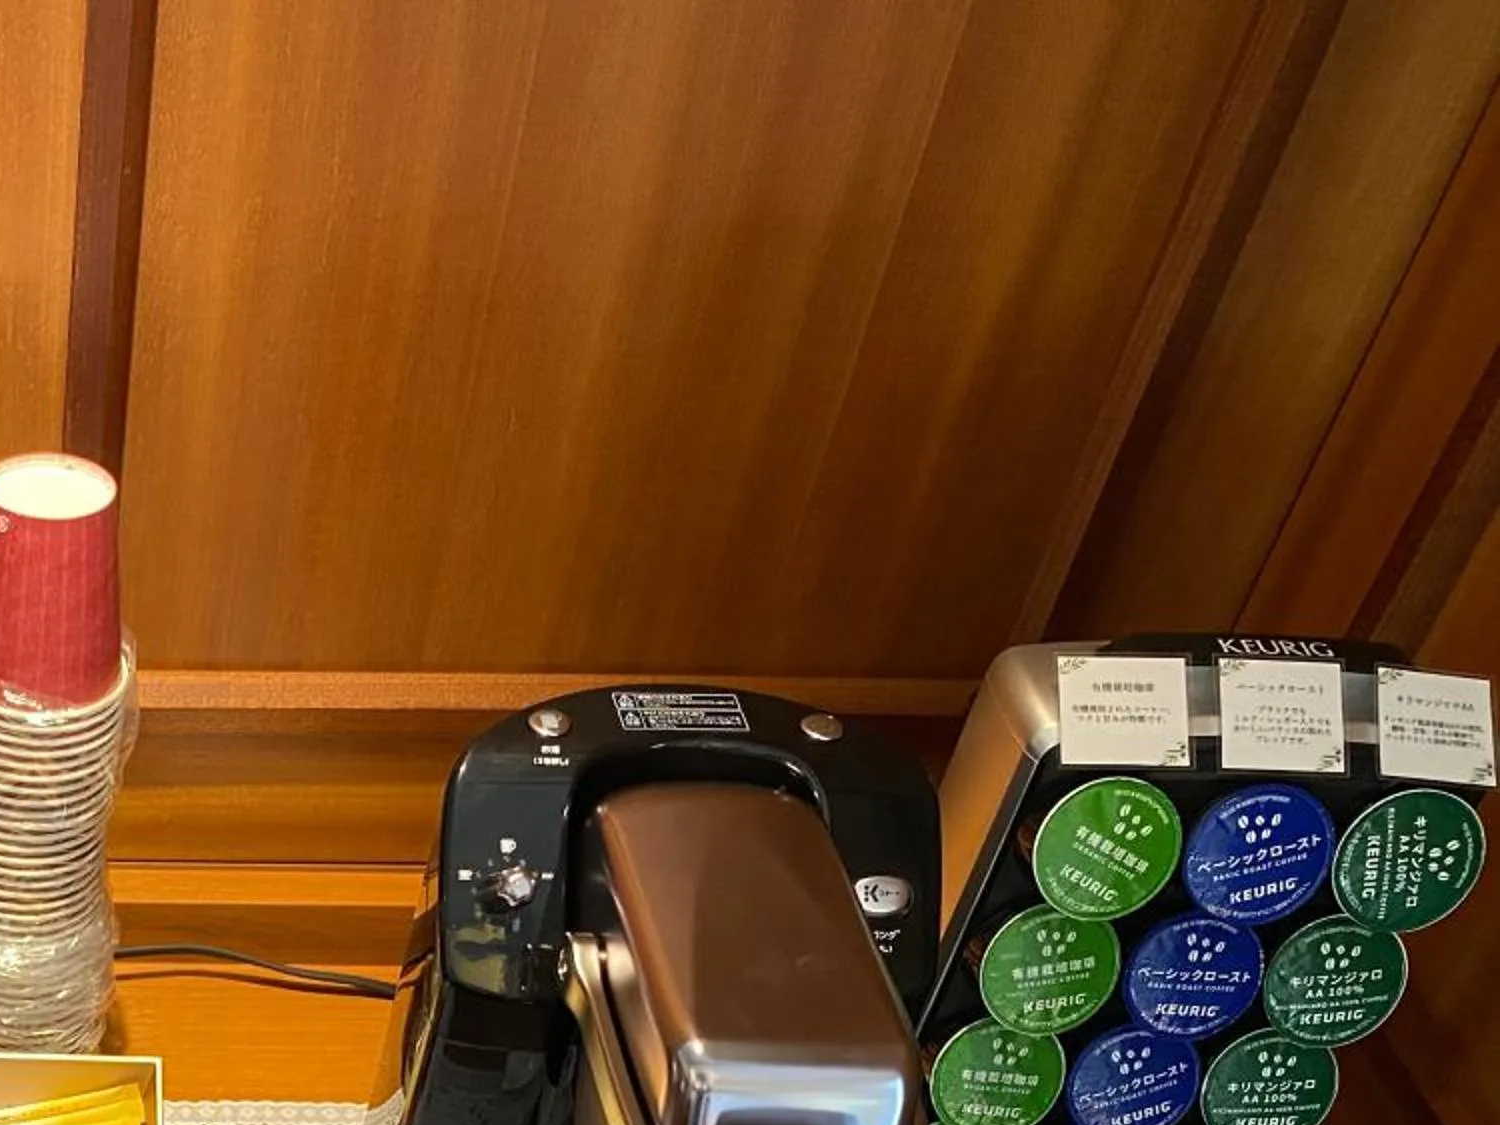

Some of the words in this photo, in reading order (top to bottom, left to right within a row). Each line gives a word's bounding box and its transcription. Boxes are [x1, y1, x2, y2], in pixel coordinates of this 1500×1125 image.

[1217, 638, 1336, 658] KEURIG
[1197, 833, 1322, 873] ベーシックロースト
[1361, 834, 1381, 900] KEURIG
[1059, 863, 1119, 901] KEURIG
[1229, 877, 1299, 904] KEURIG
[1137, 966, 1252, 984] ベーシックロースト
[1022, 993, 1088, 1014] KEURIG
[1304, 989, 1324, 999] AA
[1155, 1002, 1221, 1017] KEURIG
[1299, 1008, 1367, 1026] KEURIG
[1079, 1061, 1188, 1103] ベーシックロースト
[1241, 1095, 1260, 1104] AA
[1263, 1093, 1298, 1104] 100%
[961, 1102, 1024, 1119] KEURIG
